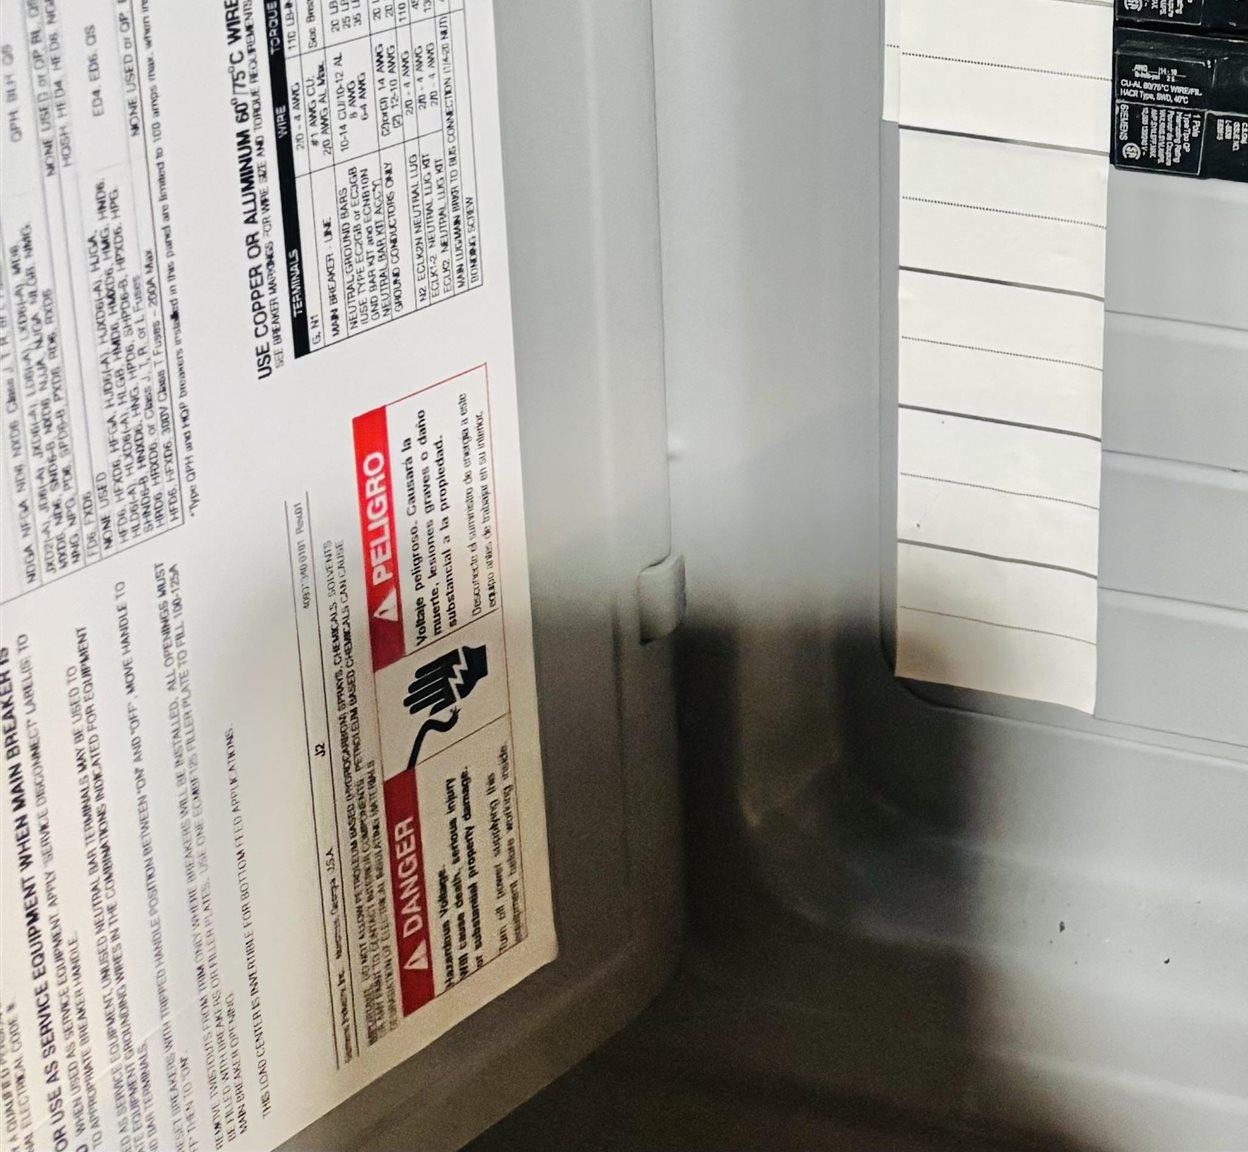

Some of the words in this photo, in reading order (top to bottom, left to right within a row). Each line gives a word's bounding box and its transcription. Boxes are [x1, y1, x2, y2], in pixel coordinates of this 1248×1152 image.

[266, 0, 280, 54] TORQUE
[275, 104, 287, 138] WIRE
[235, 128, 258, 224] ALUMINUM
[383, 162, 393, 188] ONLY
[245, 230, 261, 259] OR
[322, 217, 332, 242] LINE
[386, 190, 399, 263] CONDUCTORS
[248, 263, 268, 338] COPPER
[288, 248, 302, 317] TERMINALS
[325, 252, 338, 305] BREAKER
[391, 266, 403, 311] GROUND
[330, 307, 339, 336] MAIN
[255, 341, 272, 379] USE
[401, 436, 411, 452] la
[415, 409, 427, 445] daño
[402, 455, 416, 516] Causará
[421, 465, 435, 513] graves
[433, 434, 450, 511] propiedad.
[362, 450, 393, 585] PELIGRO
[439, 515, 449, 530] la
[410, 520, 425, 591] peligroso.
[426, 518, 437, 579] lesiones
[429, 582, 442, 636] muerte,
[441, 548, 457, 627] substancial
[414, 596, 428, 646] Voltaje
[0, 671, 20, 759] BREAKER
[314, 741, 326, 756] J2
[8, 762, 26, 812] MAIN
[445, 777, 457, 814] injury
[460, 765, 472, 821] damage.
[14, 813, 33, 872] WHEN
[448, 816, 460, 864] serious
[464, 824, 479, 878] property
[394, 815, 422, 938] DANGER
[437, 864, 448, 918] Voltage.
[451, 866, 464, 908] death,
[21, 875, 46, 980] EQUIPMENT
[456, 911, 467, 950] cause
[467, 881, 482, 950] substantial
[441, 919, 454, 988] Hazardous
[457, 952, 472, 981] Will
[475, 954, 483, 968] or
[34, 980, 56, 1058] SERVICE
[44, 1059, 59, 1083] AS
[48, 1085, 64, 1124] USE
